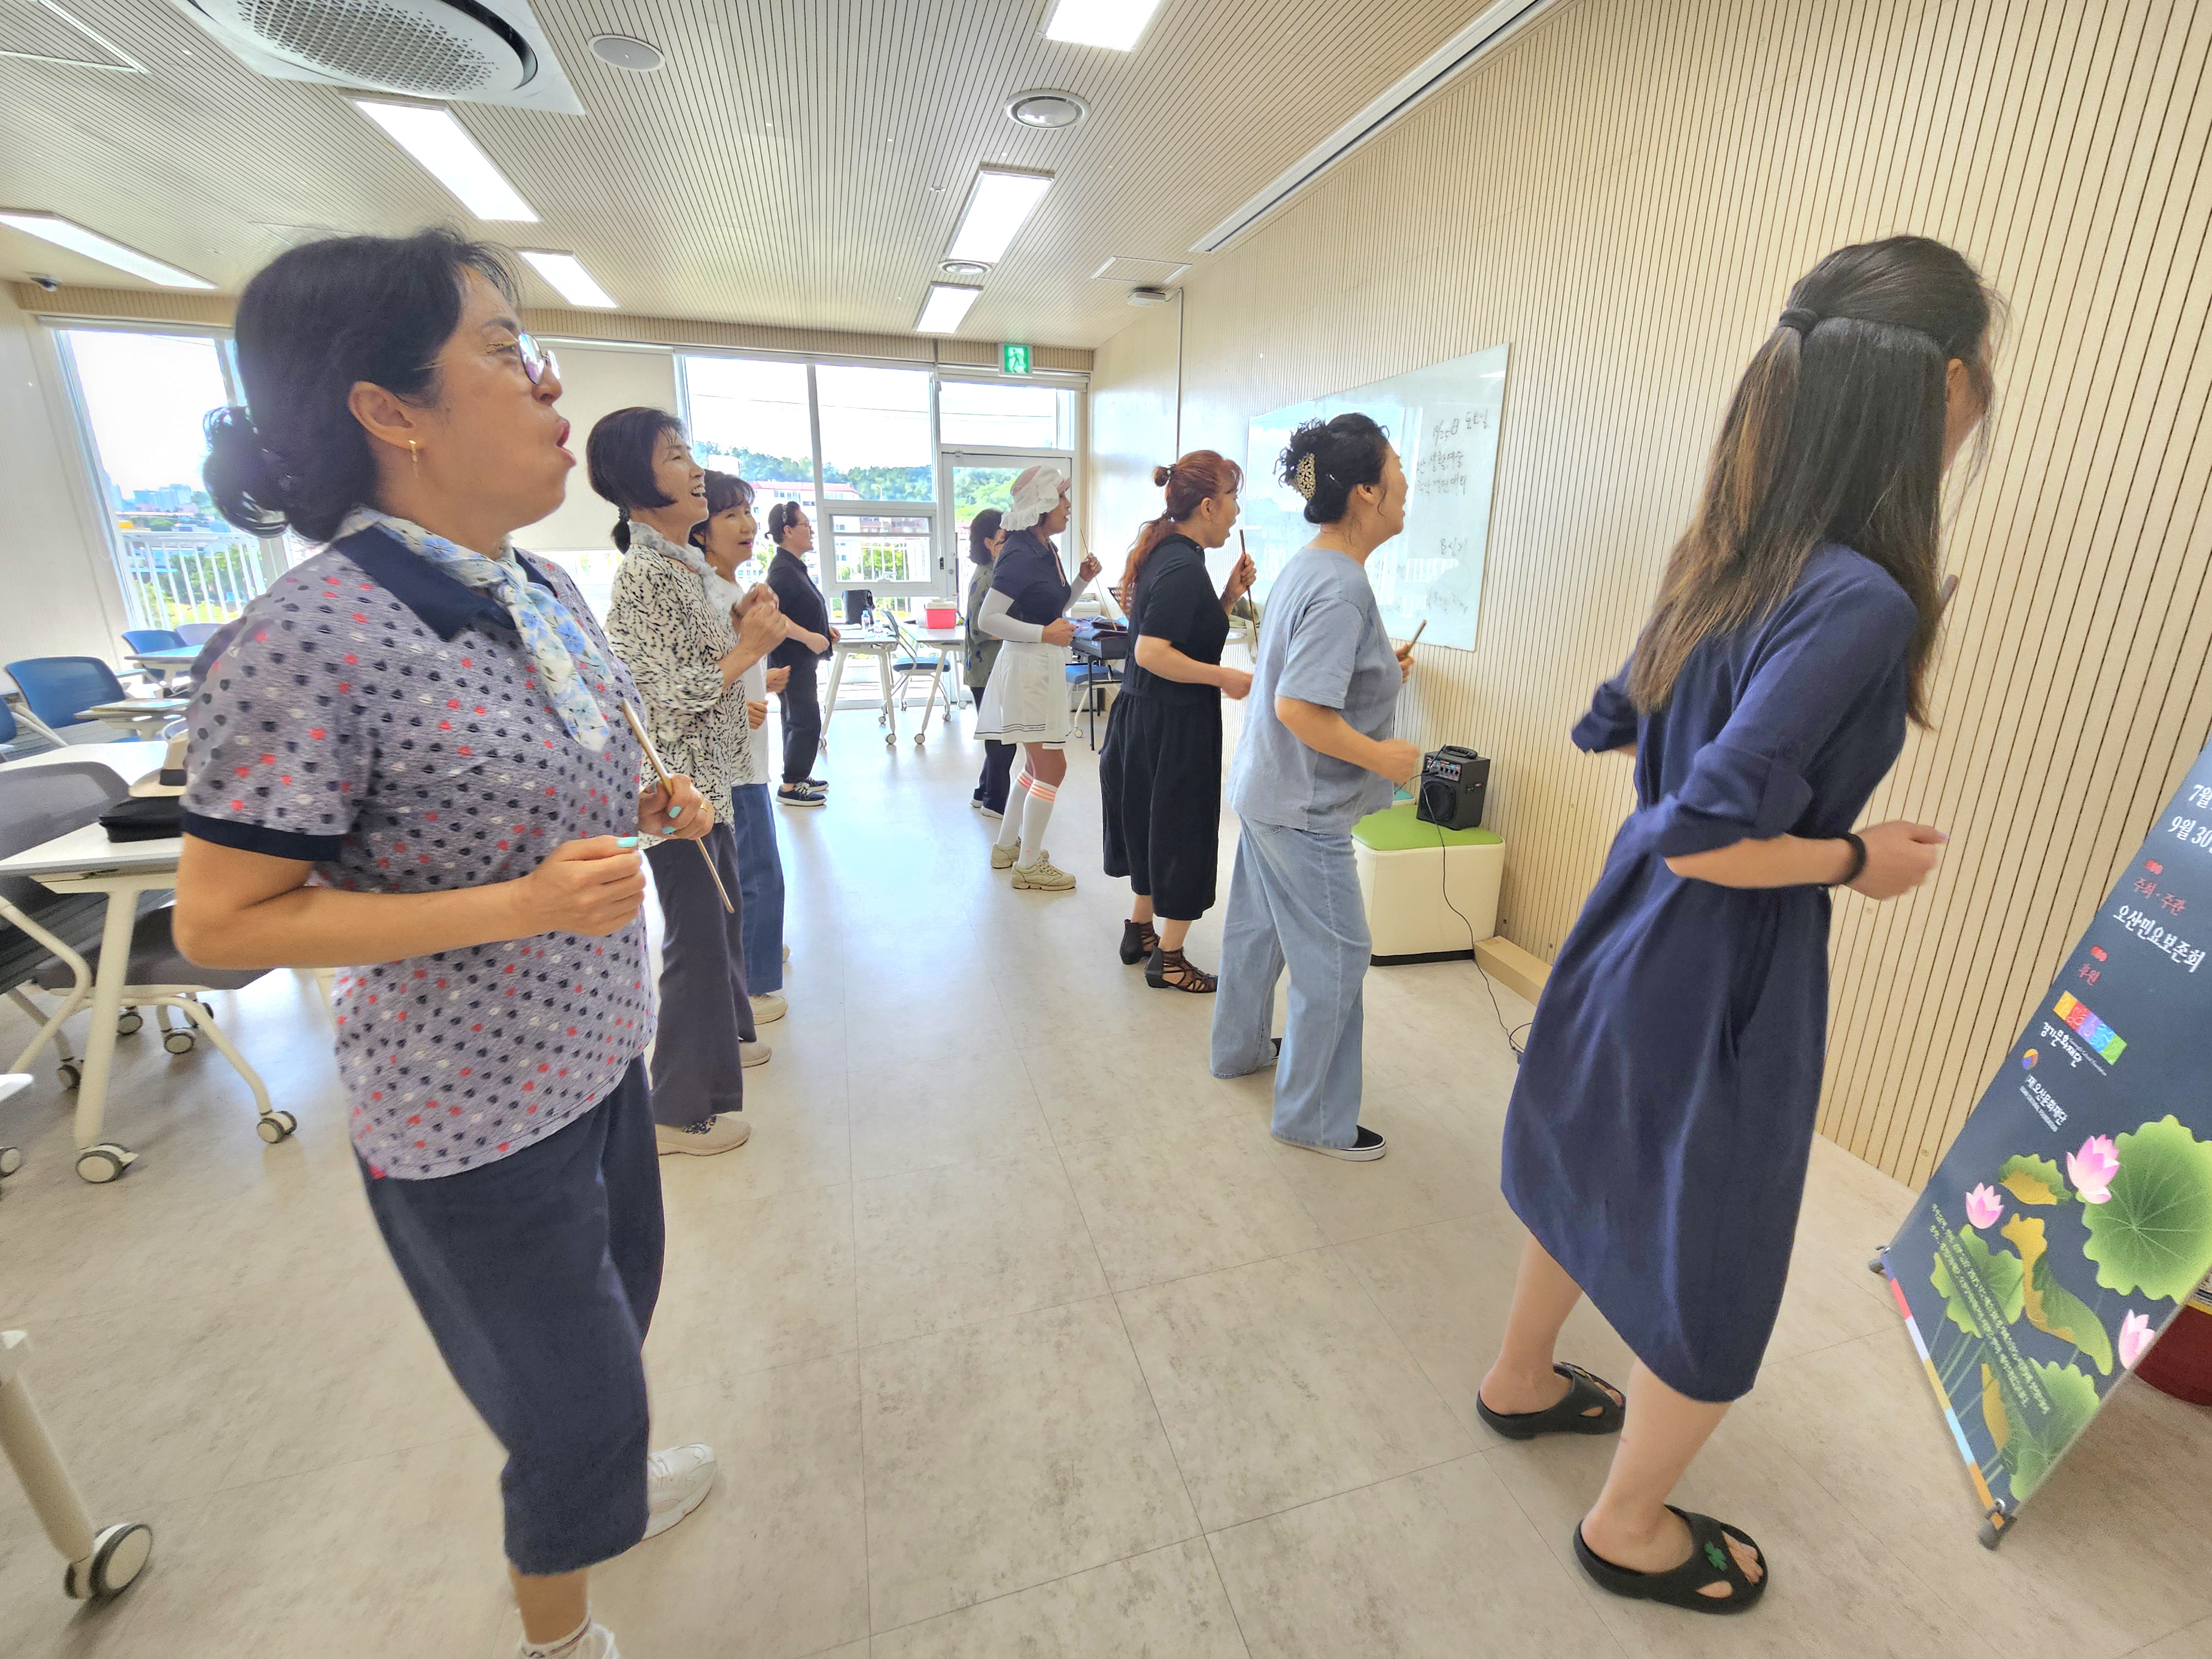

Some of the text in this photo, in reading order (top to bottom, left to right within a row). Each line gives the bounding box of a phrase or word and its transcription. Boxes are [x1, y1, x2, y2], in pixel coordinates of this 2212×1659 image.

[2168, 816, 2212, 854] 9월 30
[2113, 905, 2206, 973] 오산민요보존회
[2041, 1022, 2083, 1067] 경기문화재단
